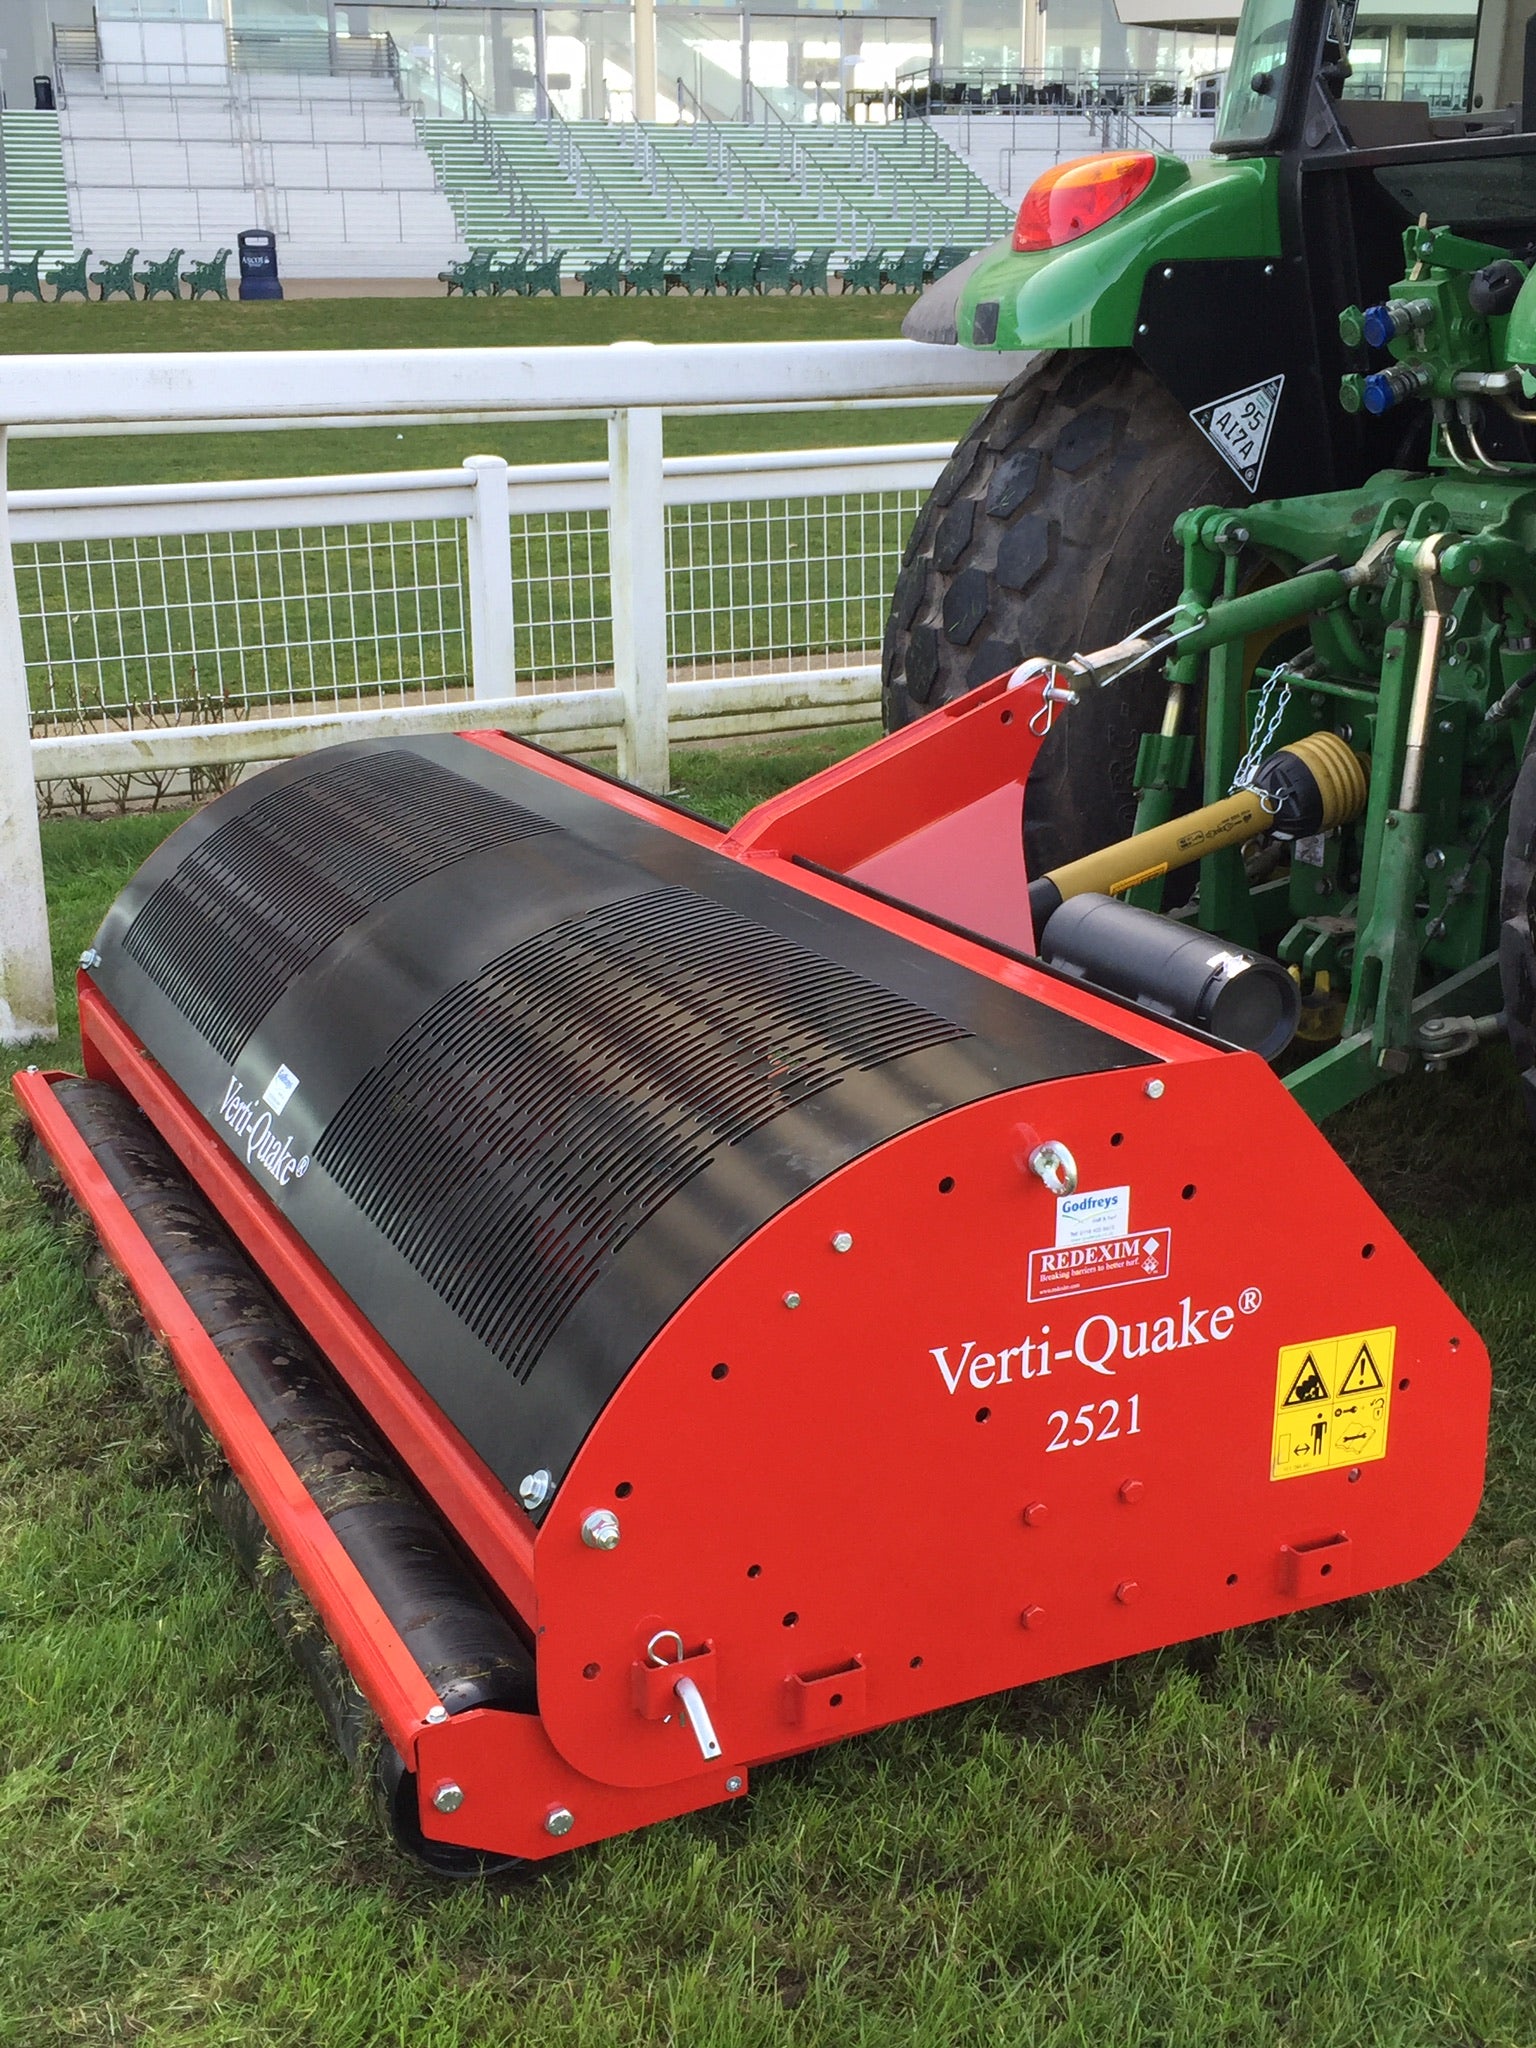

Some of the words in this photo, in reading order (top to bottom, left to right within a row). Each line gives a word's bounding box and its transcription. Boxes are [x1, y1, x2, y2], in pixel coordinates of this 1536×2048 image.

[1240, 401, 1266, 431] 95
[1062, 1195, 1118, 1213] Godfreys
[1040, 1239, 1140, 1273] REDEXIM
[1040, 1271, 1070, 1282] Breaking
[1071, 1266, 1097, 1276] barriers
[1105, 1261, 1124, 1270] better
[1045, 1393, 1142, 1452] 2521
